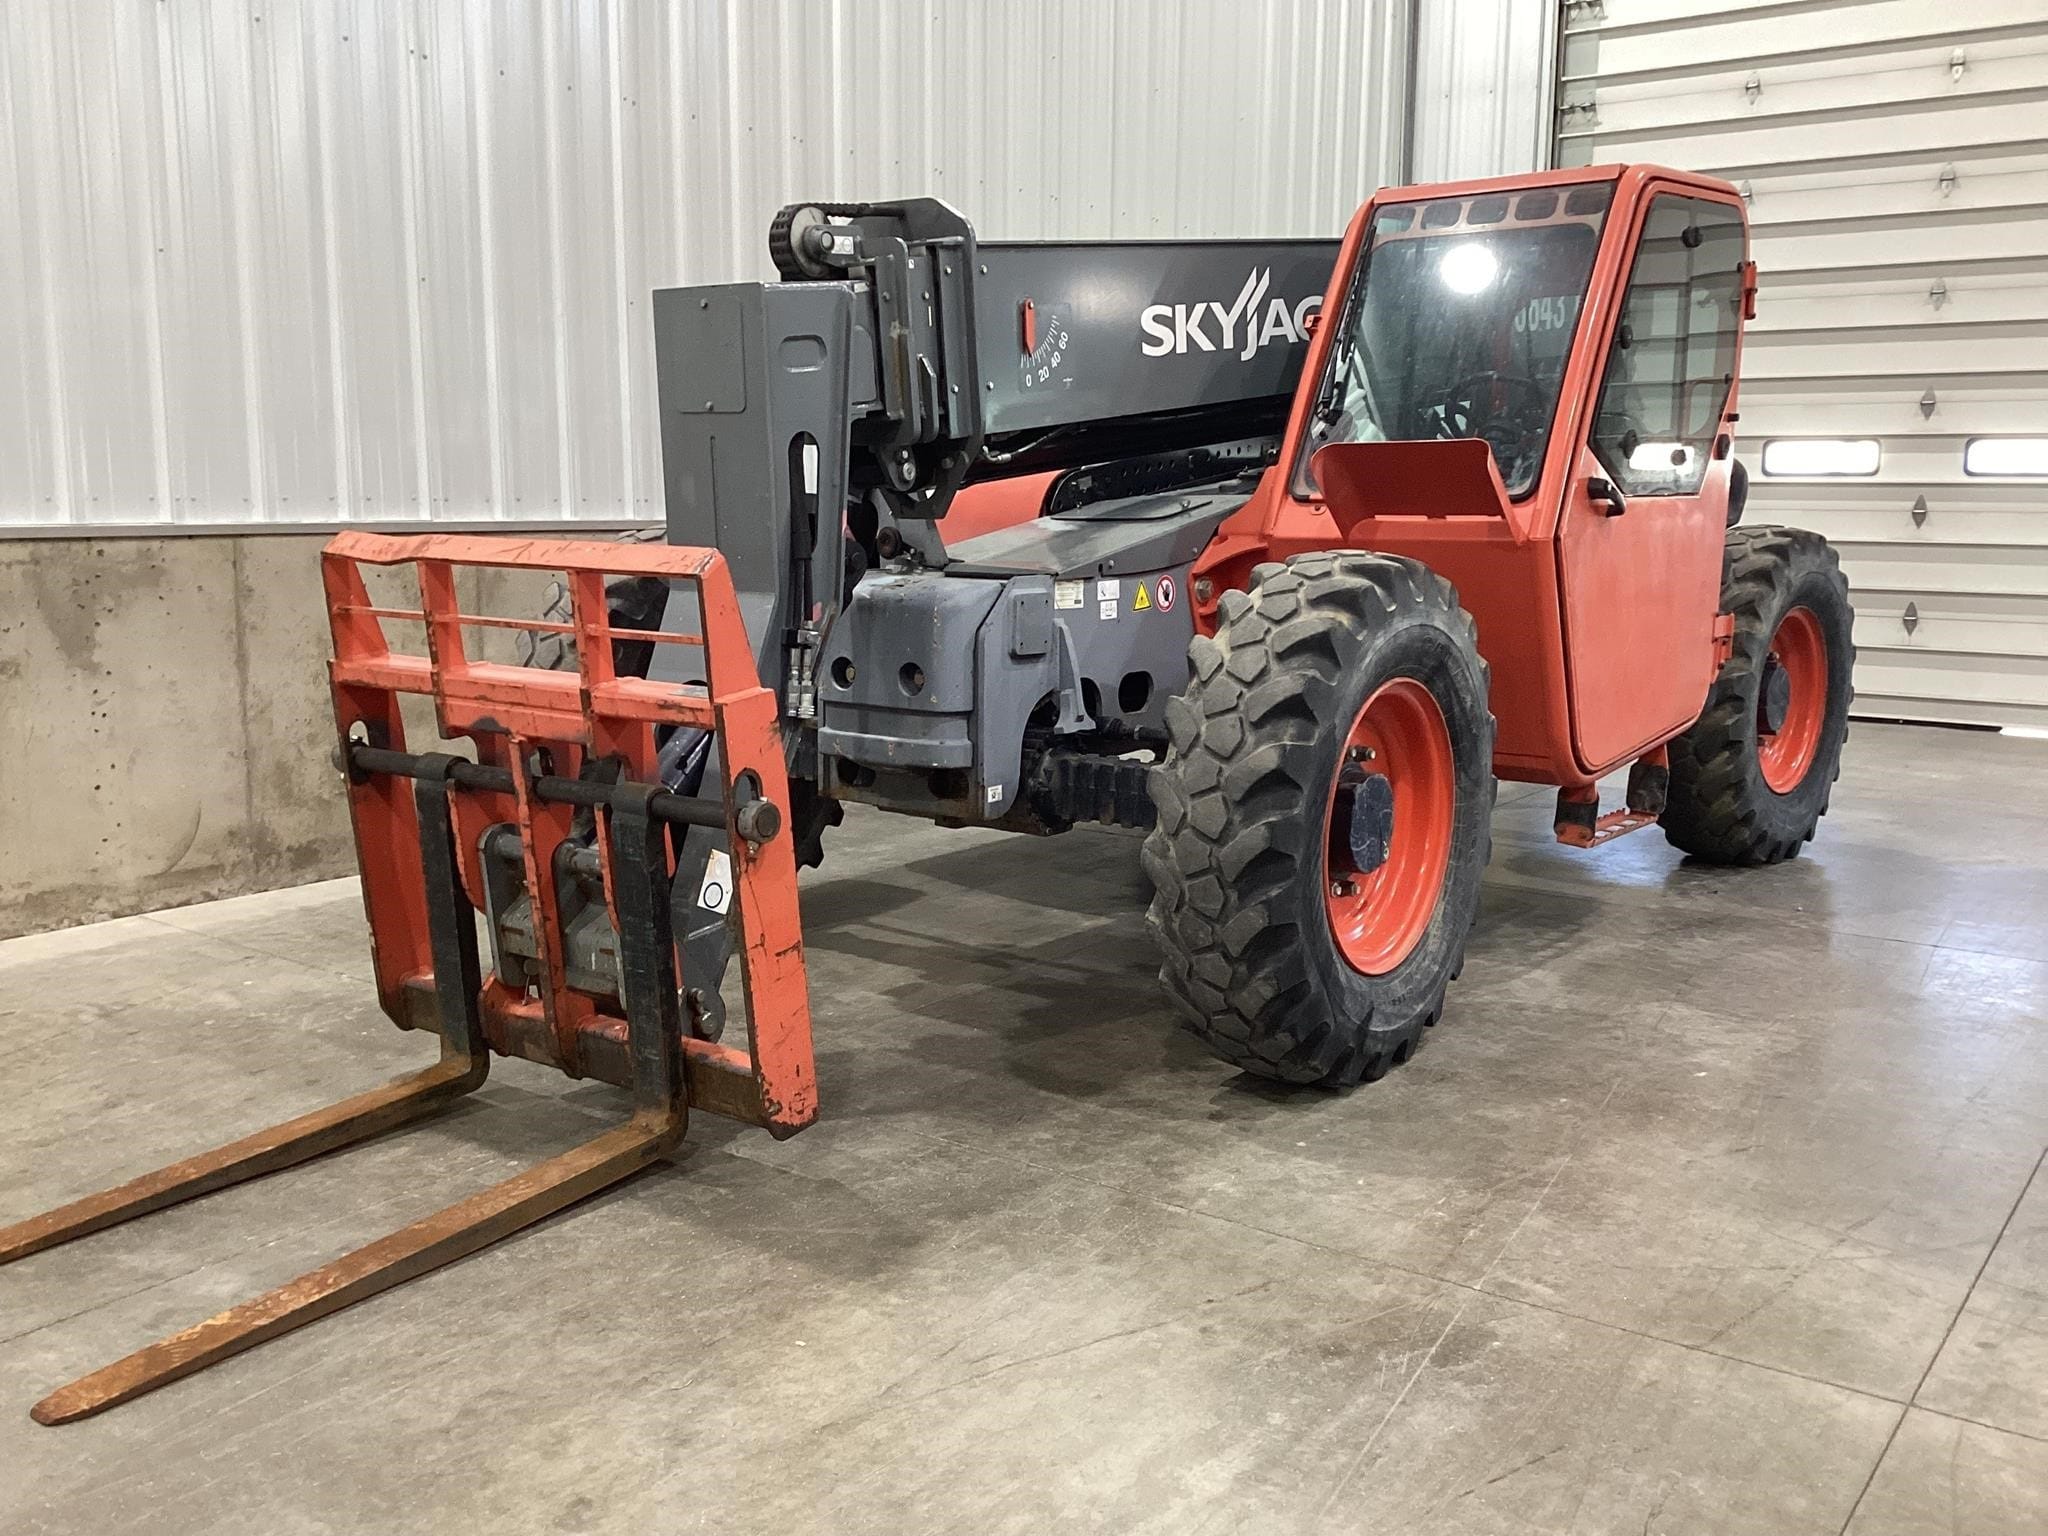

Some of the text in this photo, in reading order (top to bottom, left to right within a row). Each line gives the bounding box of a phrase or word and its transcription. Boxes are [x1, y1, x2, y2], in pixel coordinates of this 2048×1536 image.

[1026, 332, 1068, 387] 0 20 40 60
